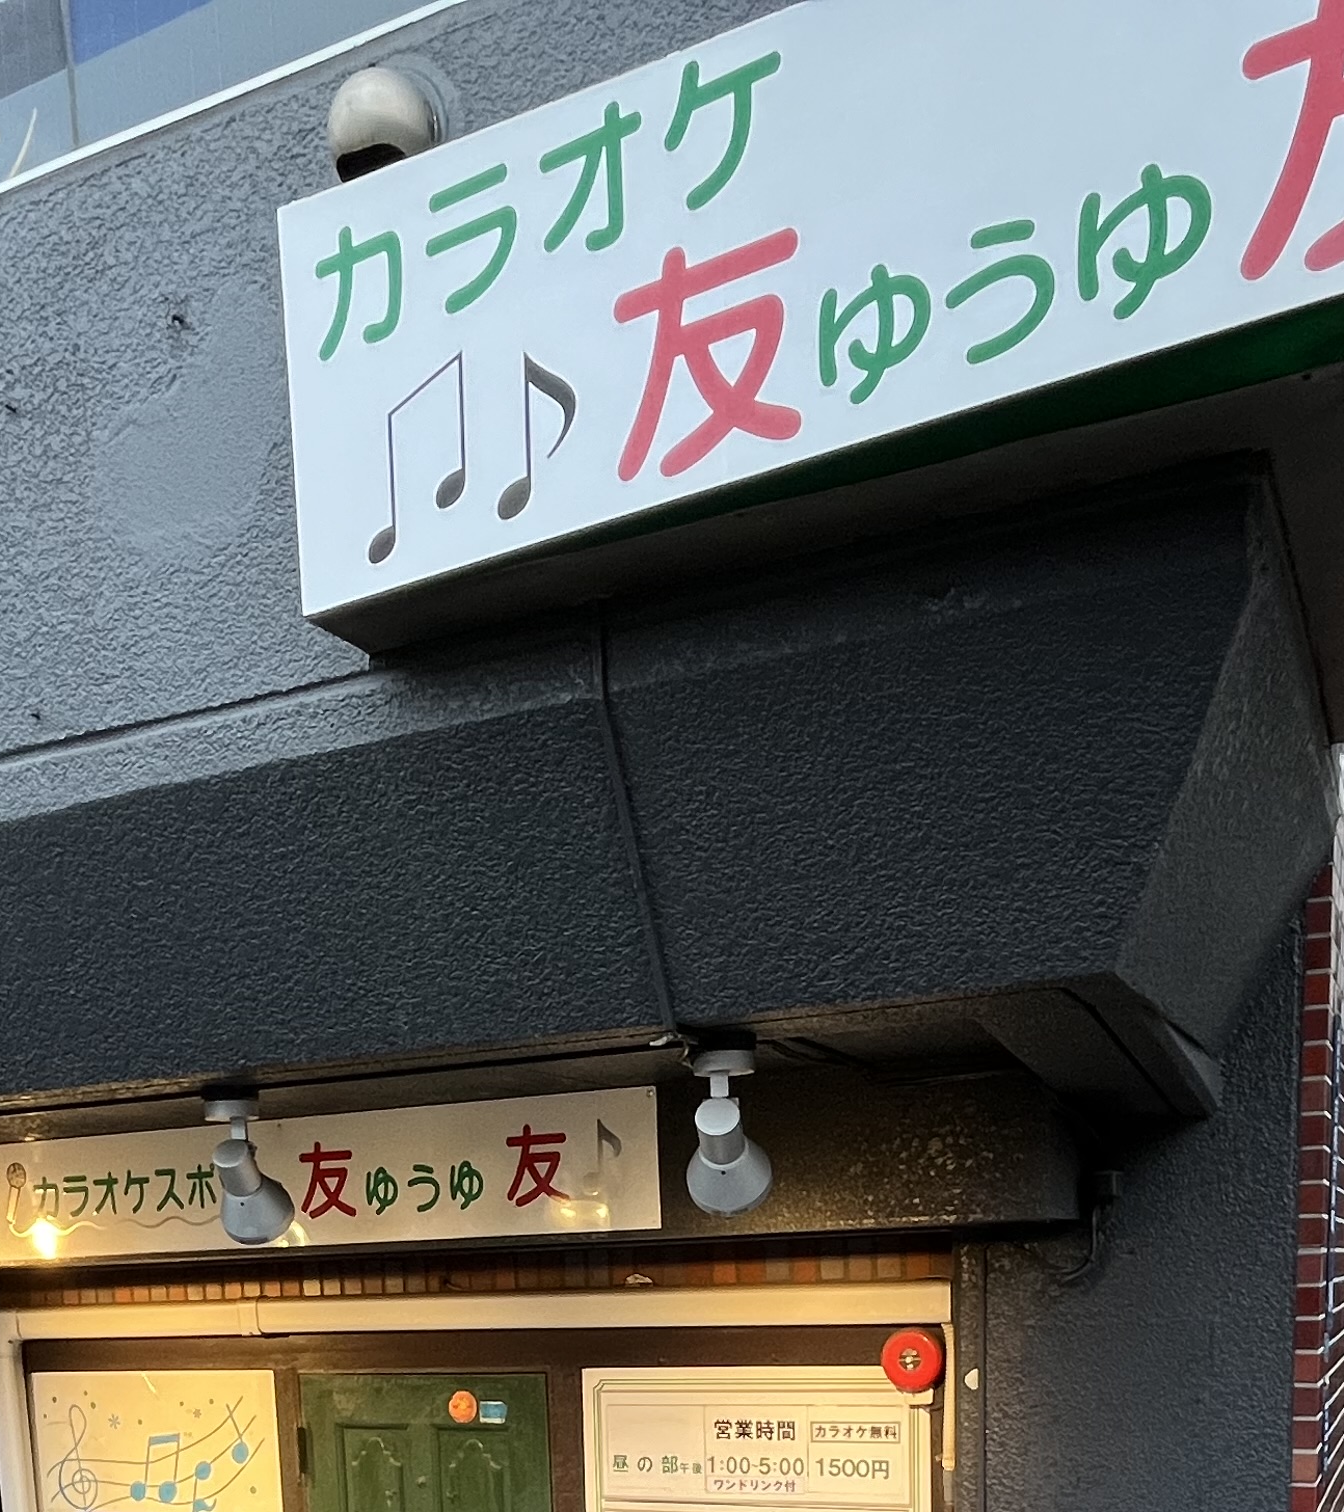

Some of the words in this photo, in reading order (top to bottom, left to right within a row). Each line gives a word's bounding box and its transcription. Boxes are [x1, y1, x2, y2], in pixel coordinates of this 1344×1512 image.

[316, 50, 782, 361] カラオケ
[33, 1163, 216, 1217] カラオケスポ
[713, 1420, 796, 1441] 営業時間
[814, 1425, 898, 1441] カラオケ無料
[815, 1457, 891, 1480] 1500円
[713, 1478, 796, 1493] ワンドリンク付
